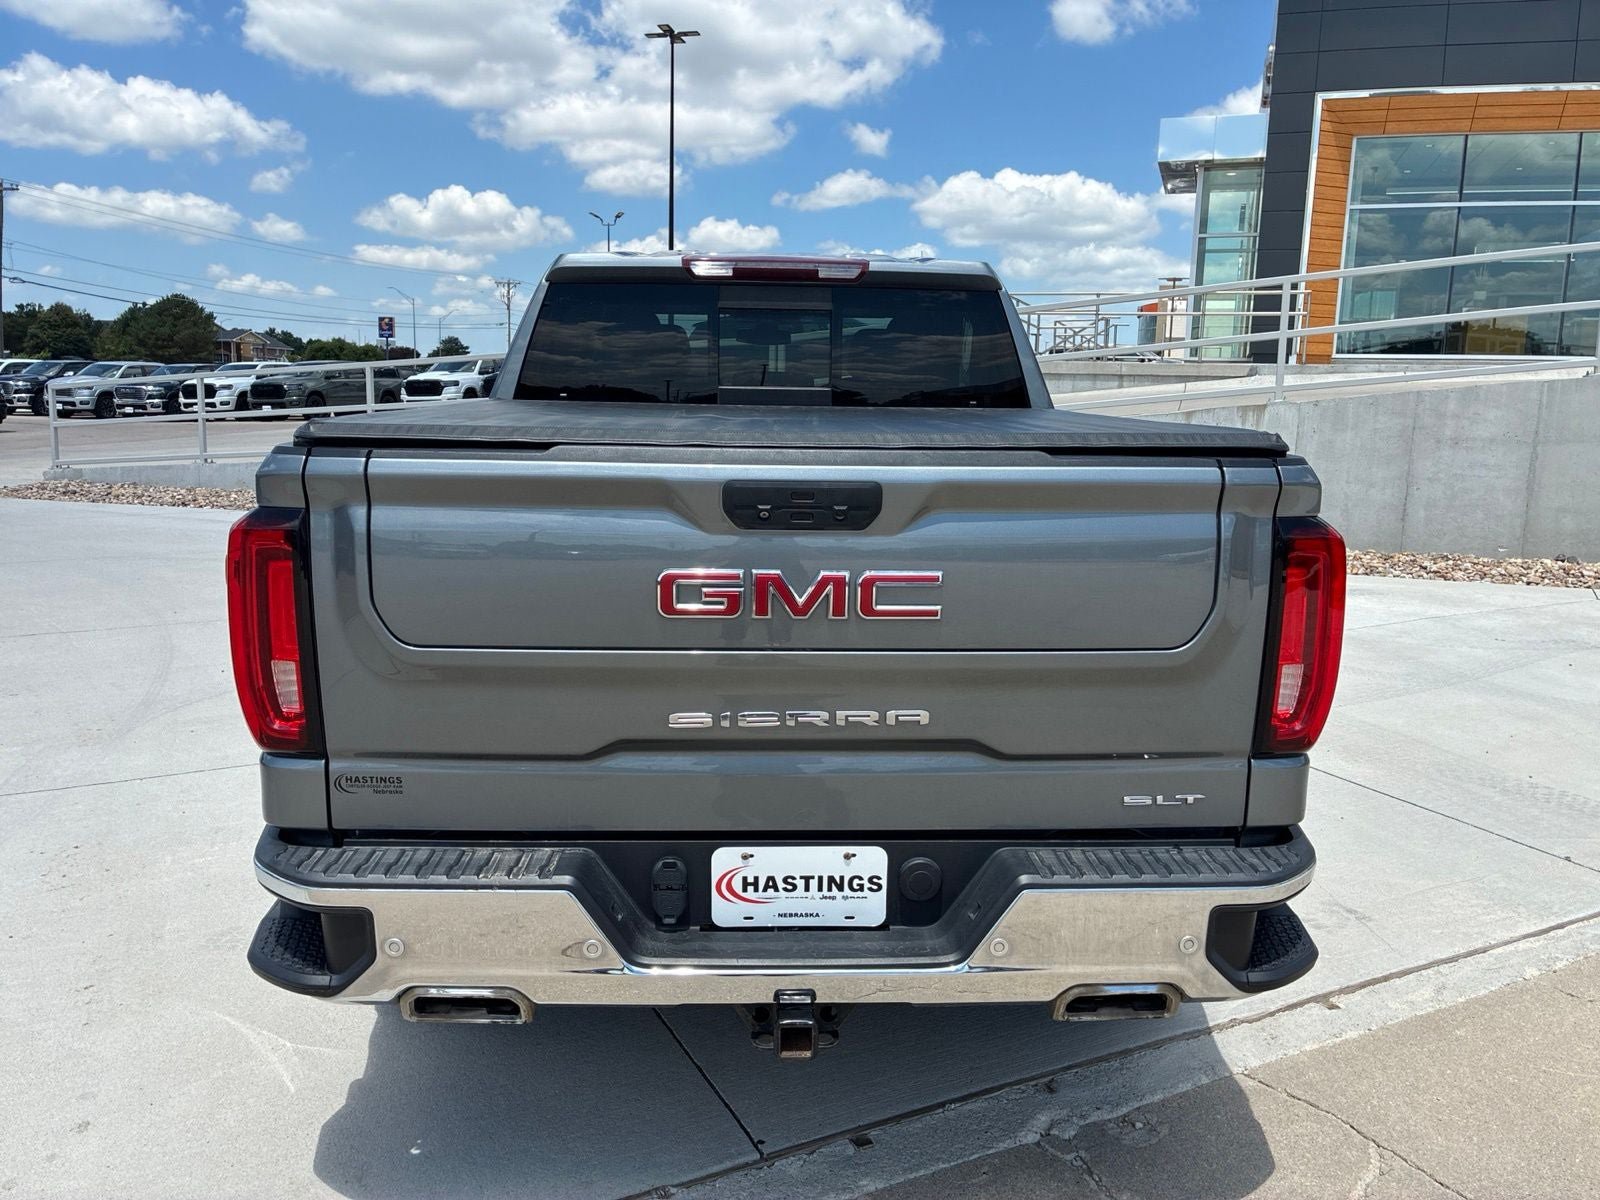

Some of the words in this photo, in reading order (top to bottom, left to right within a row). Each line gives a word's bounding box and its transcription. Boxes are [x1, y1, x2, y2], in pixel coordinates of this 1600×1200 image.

[657, 568, 943, 619] GMC
[668, 709, 930, 728] SIERRA
[345, 775, 403, 784] HASTINGS
[1123, 794, 1206, 806] SLT
[741, 875, 883, 893] HASTINGS
